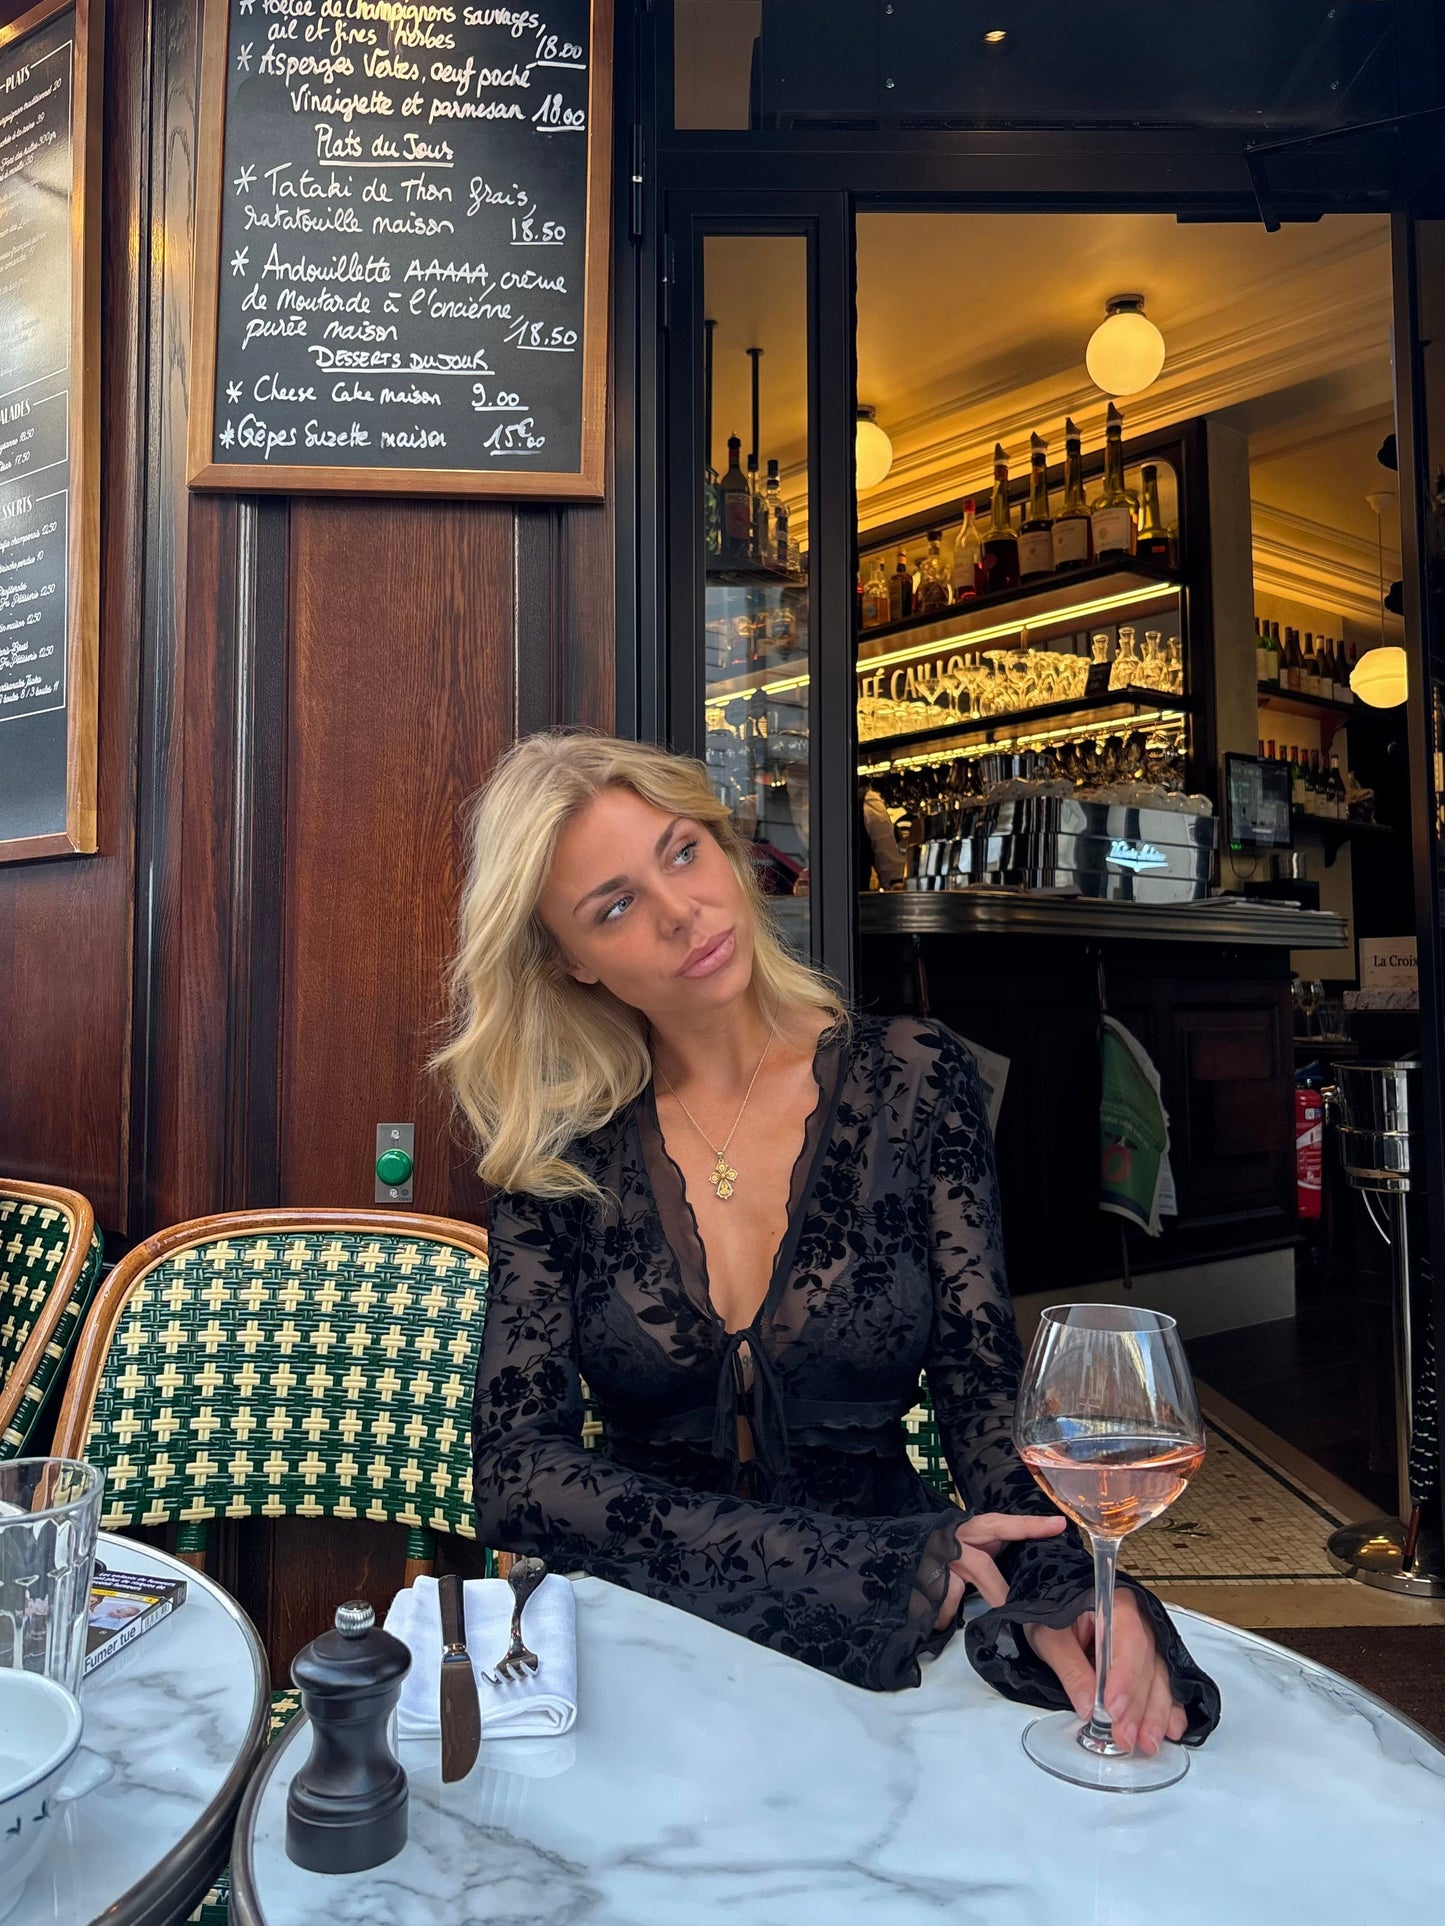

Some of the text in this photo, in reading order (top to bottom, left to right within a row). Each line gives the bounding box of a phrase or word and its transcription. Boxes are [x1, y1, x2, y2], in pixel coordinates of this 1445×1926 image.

[267, 15, 456, 56] ail et fines herbes
[320, 0, 345, 18] de
[346, 0, 456, 32] Champignons
[463, 7, 545, 38] sauvages,
[535, 35, 583, 60] 18.00
[5, 64, 30, 94] PLATS
[258, 43, 535, 98] Asperges Vertes, oeuf poché
[291, 83, 585, 126] Vinaigrette et parmesan 18.00
[314, 123, 454, 160] Plats du Jour
[264, 162, 537, 219] Tataki de Thon frais,
[244, 203, 454, 236] ratatouille maison
[511, 217, 566, 242] 18.50
[261, 242, 392, 282] Andouillette
[500, 270, 567, 293] crème
[241, 283, 267, 312] de
[383, 292, 402, 313] à
[242, 315, 307, 350] purée
[504, 321, 577, 345] 18.50
[307, 345, 401, 368] DESSERTS
[253, 372, 317, 402] Cheese
[332, 381, 375, 402] Cake
[471, 383, 520, 407] 9.00
[0, 399, 30, 425] ALADES
[304, 419, 372, 448] Suzette
[381, 425, 447, 449] maison
[1, 495, 33, 520] SSERTS
[1373, 954, 1386, 967] La
[84, 1627, 136, 1673] Fumer tue
